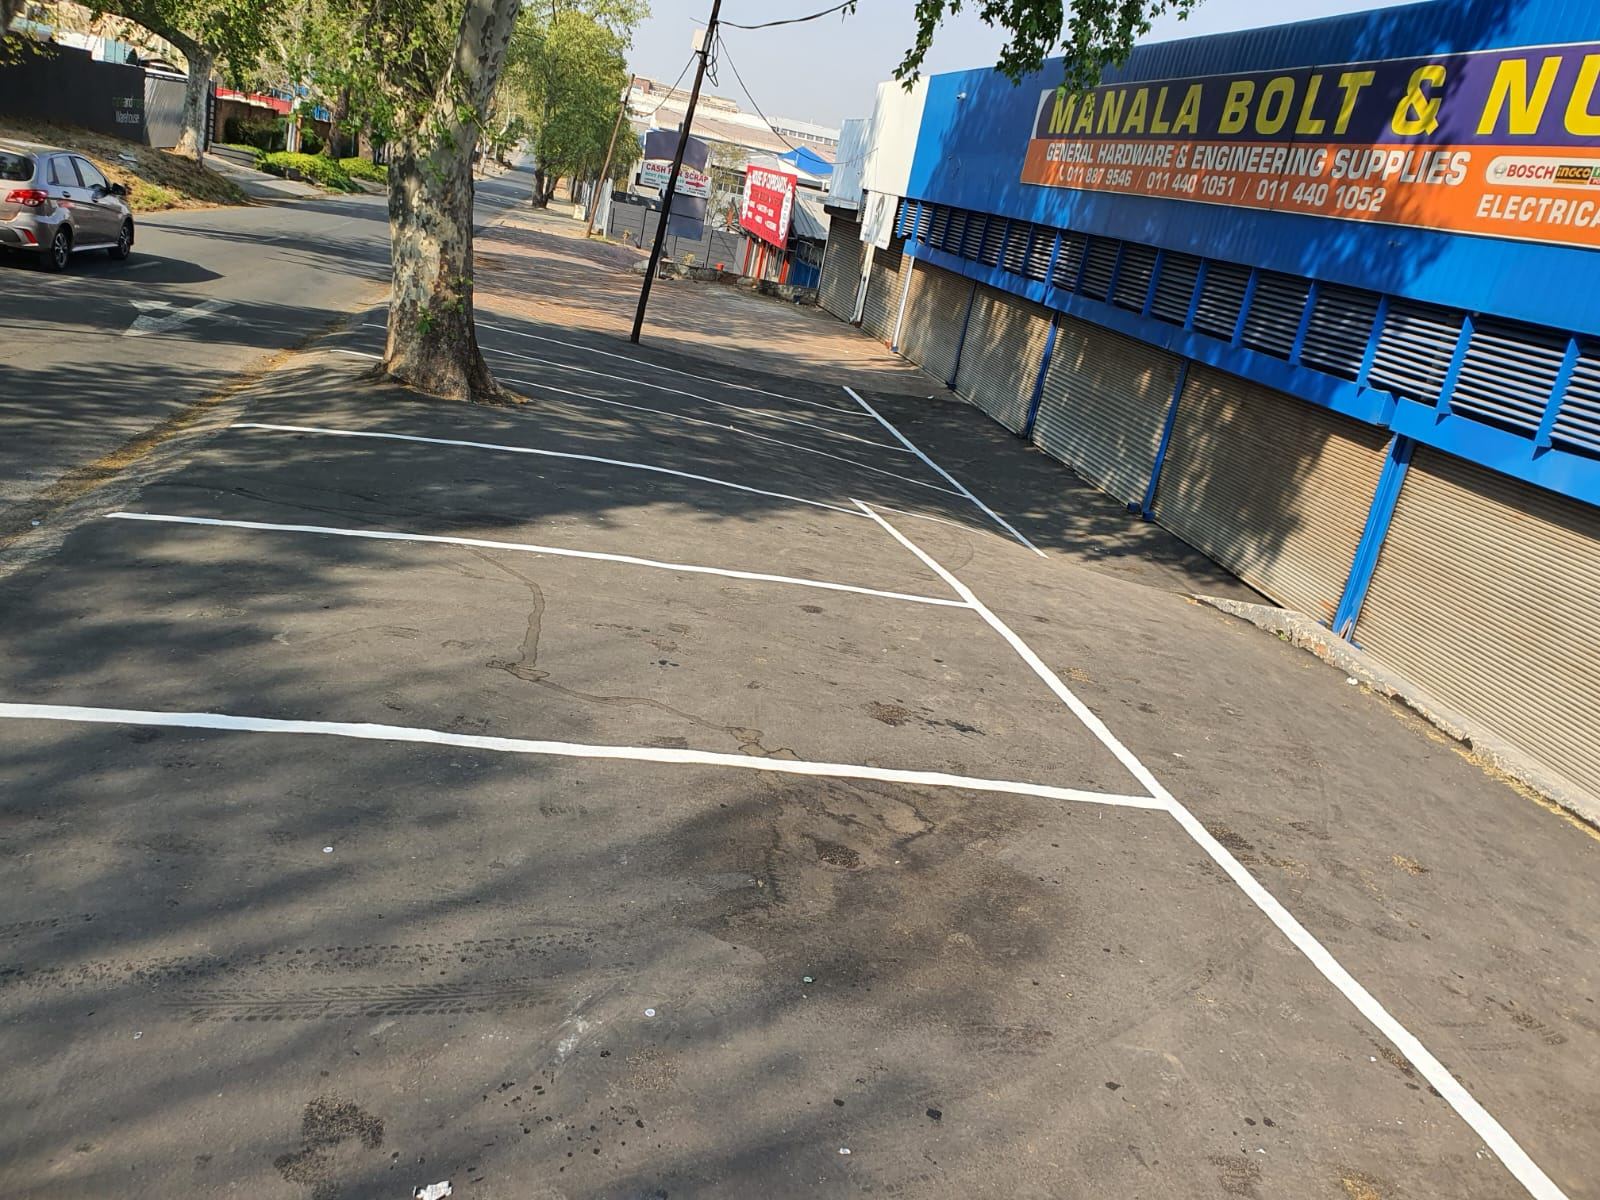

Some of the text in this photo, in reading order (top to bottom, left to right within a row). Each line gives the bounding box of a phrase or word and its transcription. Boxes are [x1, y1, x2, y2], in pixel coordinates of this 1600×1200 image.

[1048, 84, 1203, 134] MANALA
[1217, 71, 1376, 135] BOLT
[1391, 65, 1447, 136] &
[646, 163, 666, 174] CASH
[668, 167, 683, 177] FR
[684, 171, 709, 183] SCRAP
[1046, 142, 1472, 186] GENERAL HARDWARE & ENGINEERING SUPPLIES
[1506, 164, 1556, 180] BOSCH
[1066, 166, 1084, 182] 011
[1085, 167, 1104, 184] 887
[1105, 169, 1133, 187] 9546
[1146, 171, 1170, 191] 011
[1172, 174, 1198, 193] 440
[1201, 176, 1236, 197] 1051
[1256, 179, 1289, 203] 011
[1291, 182, 1328, 207] 440
[1335, 185, 1387, 213] 1052
